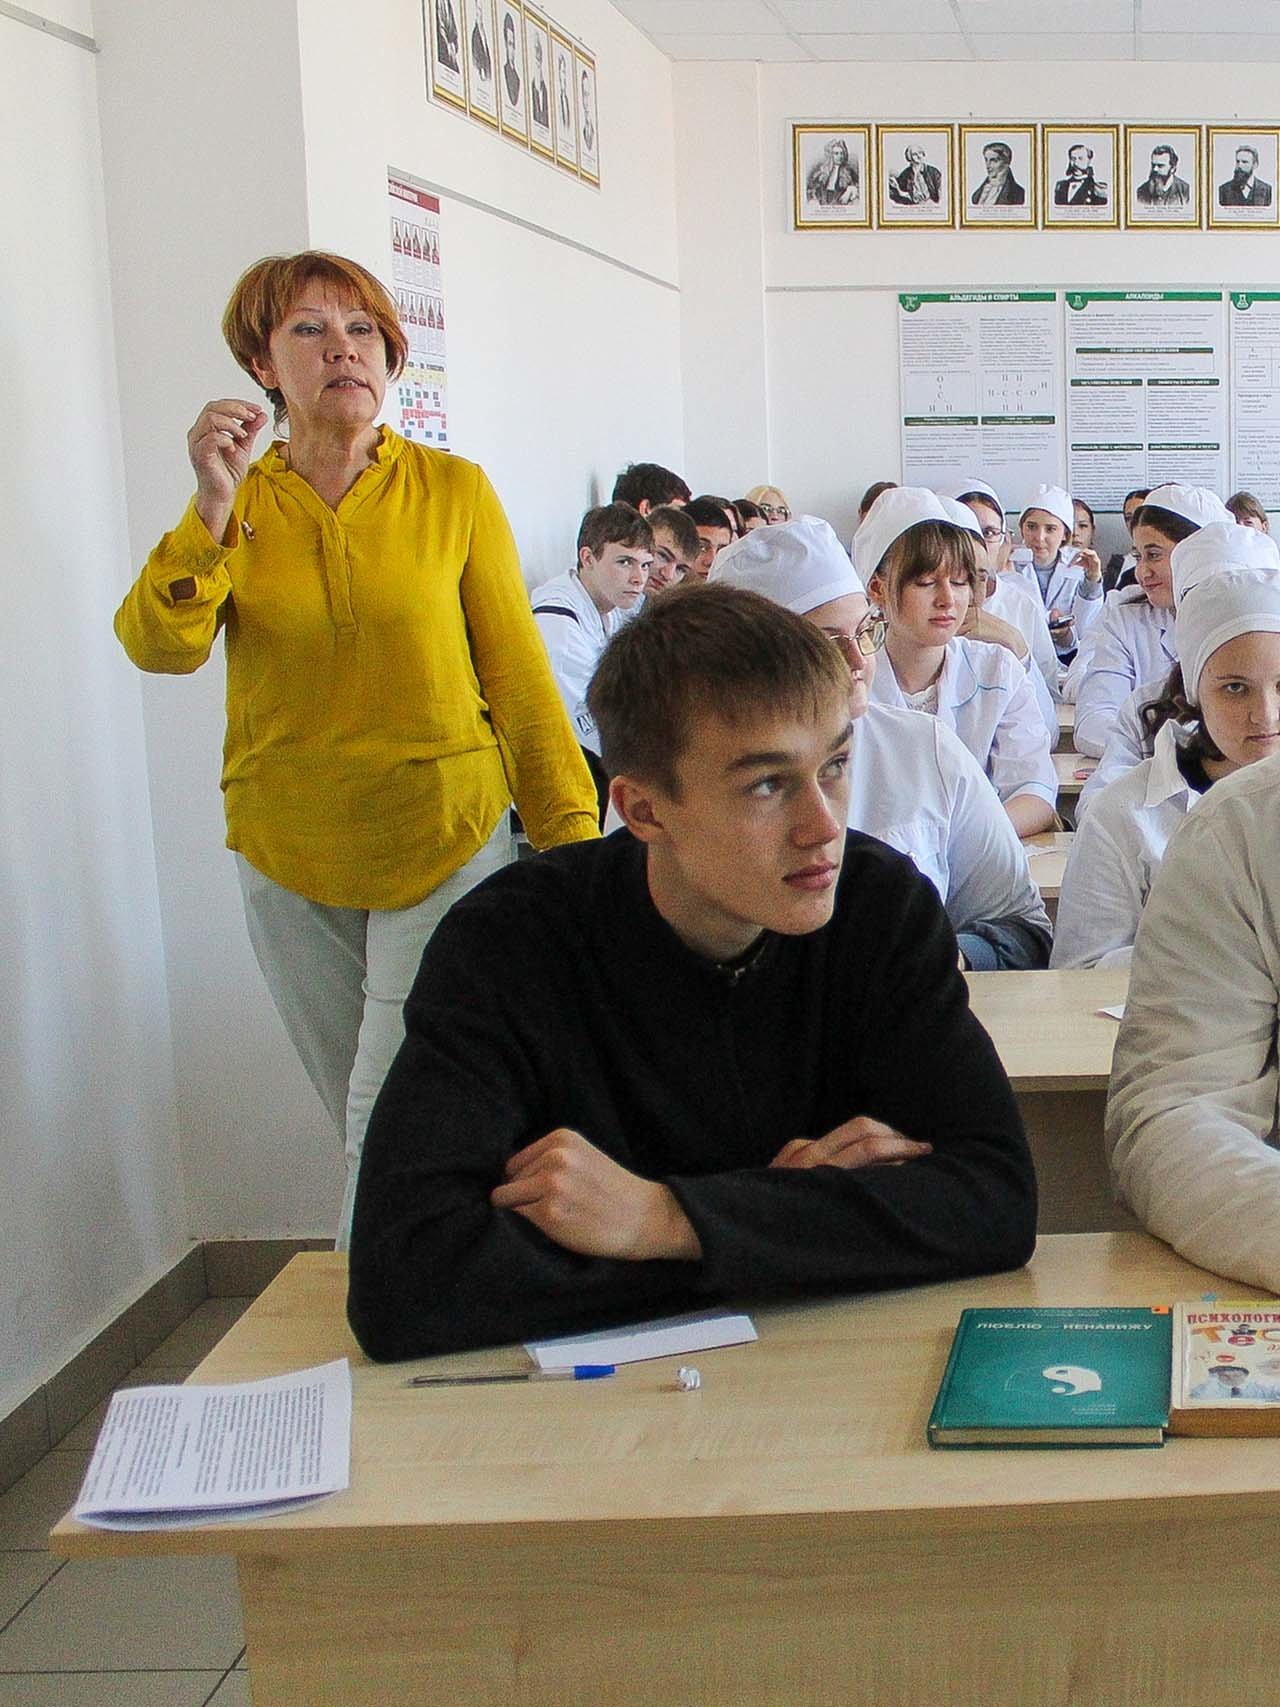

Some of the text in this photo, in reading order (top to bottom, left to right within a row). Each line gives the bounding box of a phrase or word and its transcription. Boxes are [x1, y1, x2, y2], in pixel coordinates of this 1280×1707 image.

[949, 293, 987, 302] АЛЬДЕГИДЫ
[993, 292, 1019, 301] СПИРТЫ
[976, 1322, 1042, 1330] ЛЮБЛЮ
[1063, 1322, 1153, 1331] НЕНАВИЖУ
